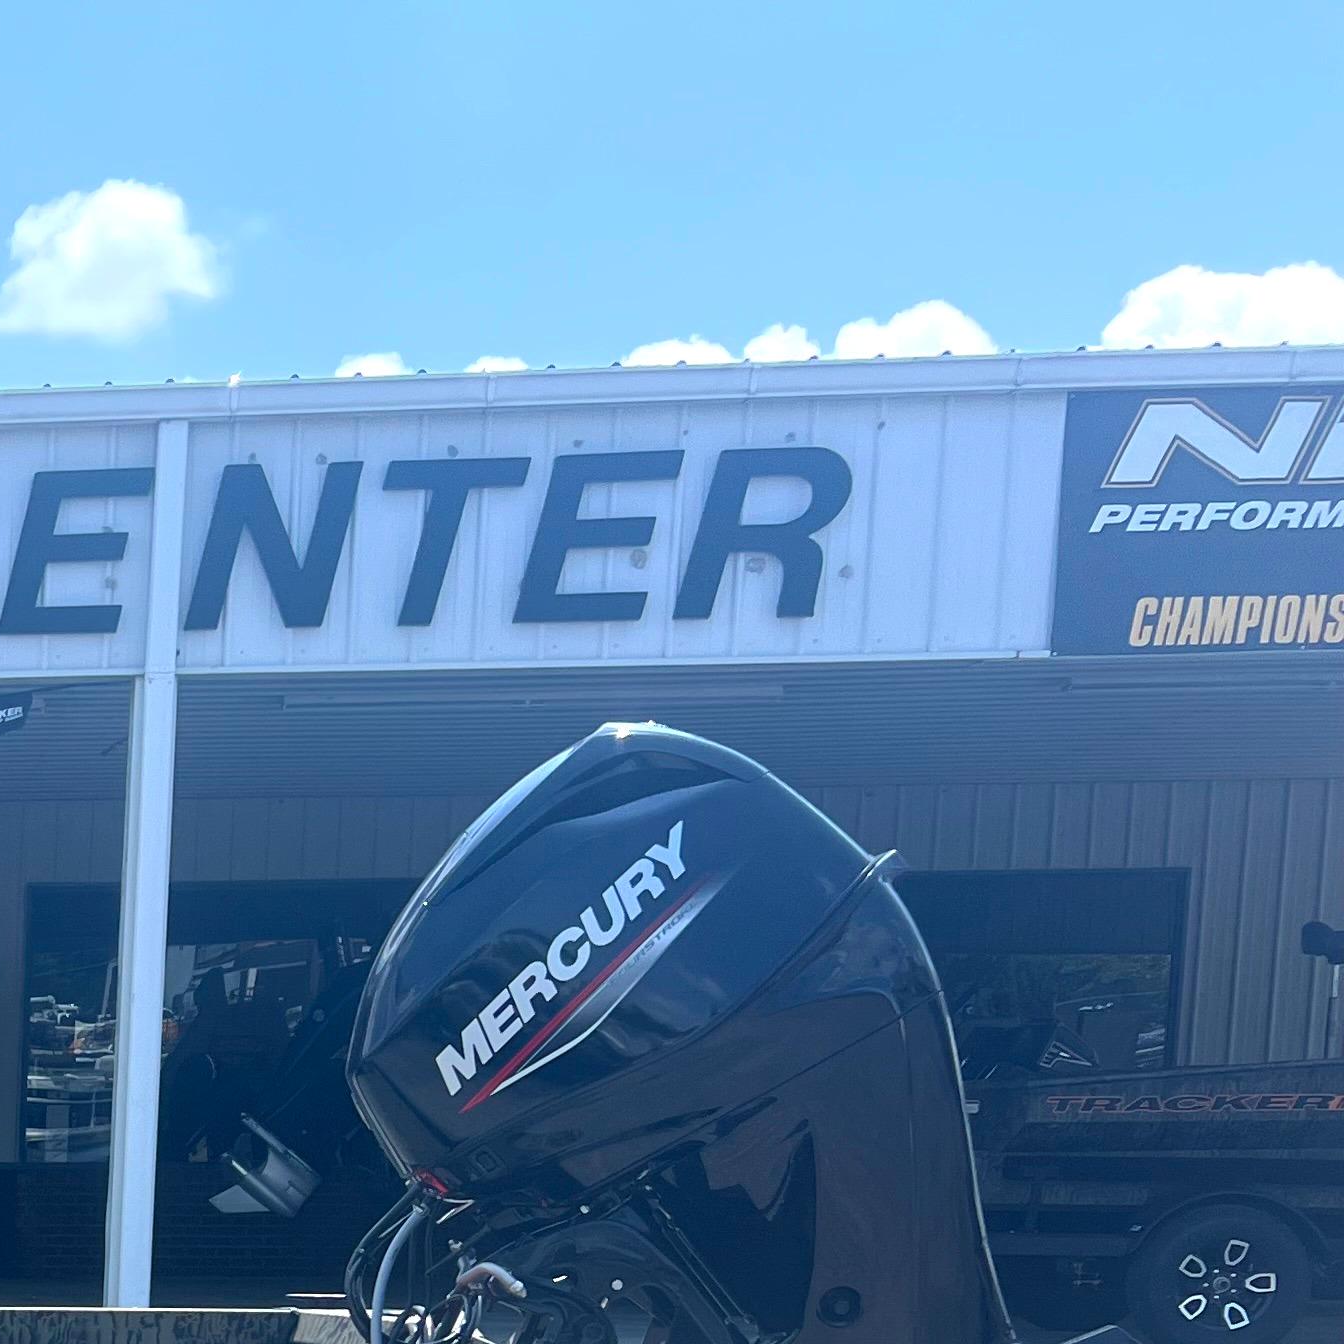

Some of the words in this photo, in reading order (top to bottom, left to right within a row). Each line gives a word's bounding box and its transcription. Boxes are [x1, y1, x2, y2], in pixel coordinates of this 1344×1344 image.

[1128, 594, 1344, 648] CHAMPIONS
[434, 820, 687, 1097] MERCURY
[1047, 1094, 1336, 1113] TRACKER
